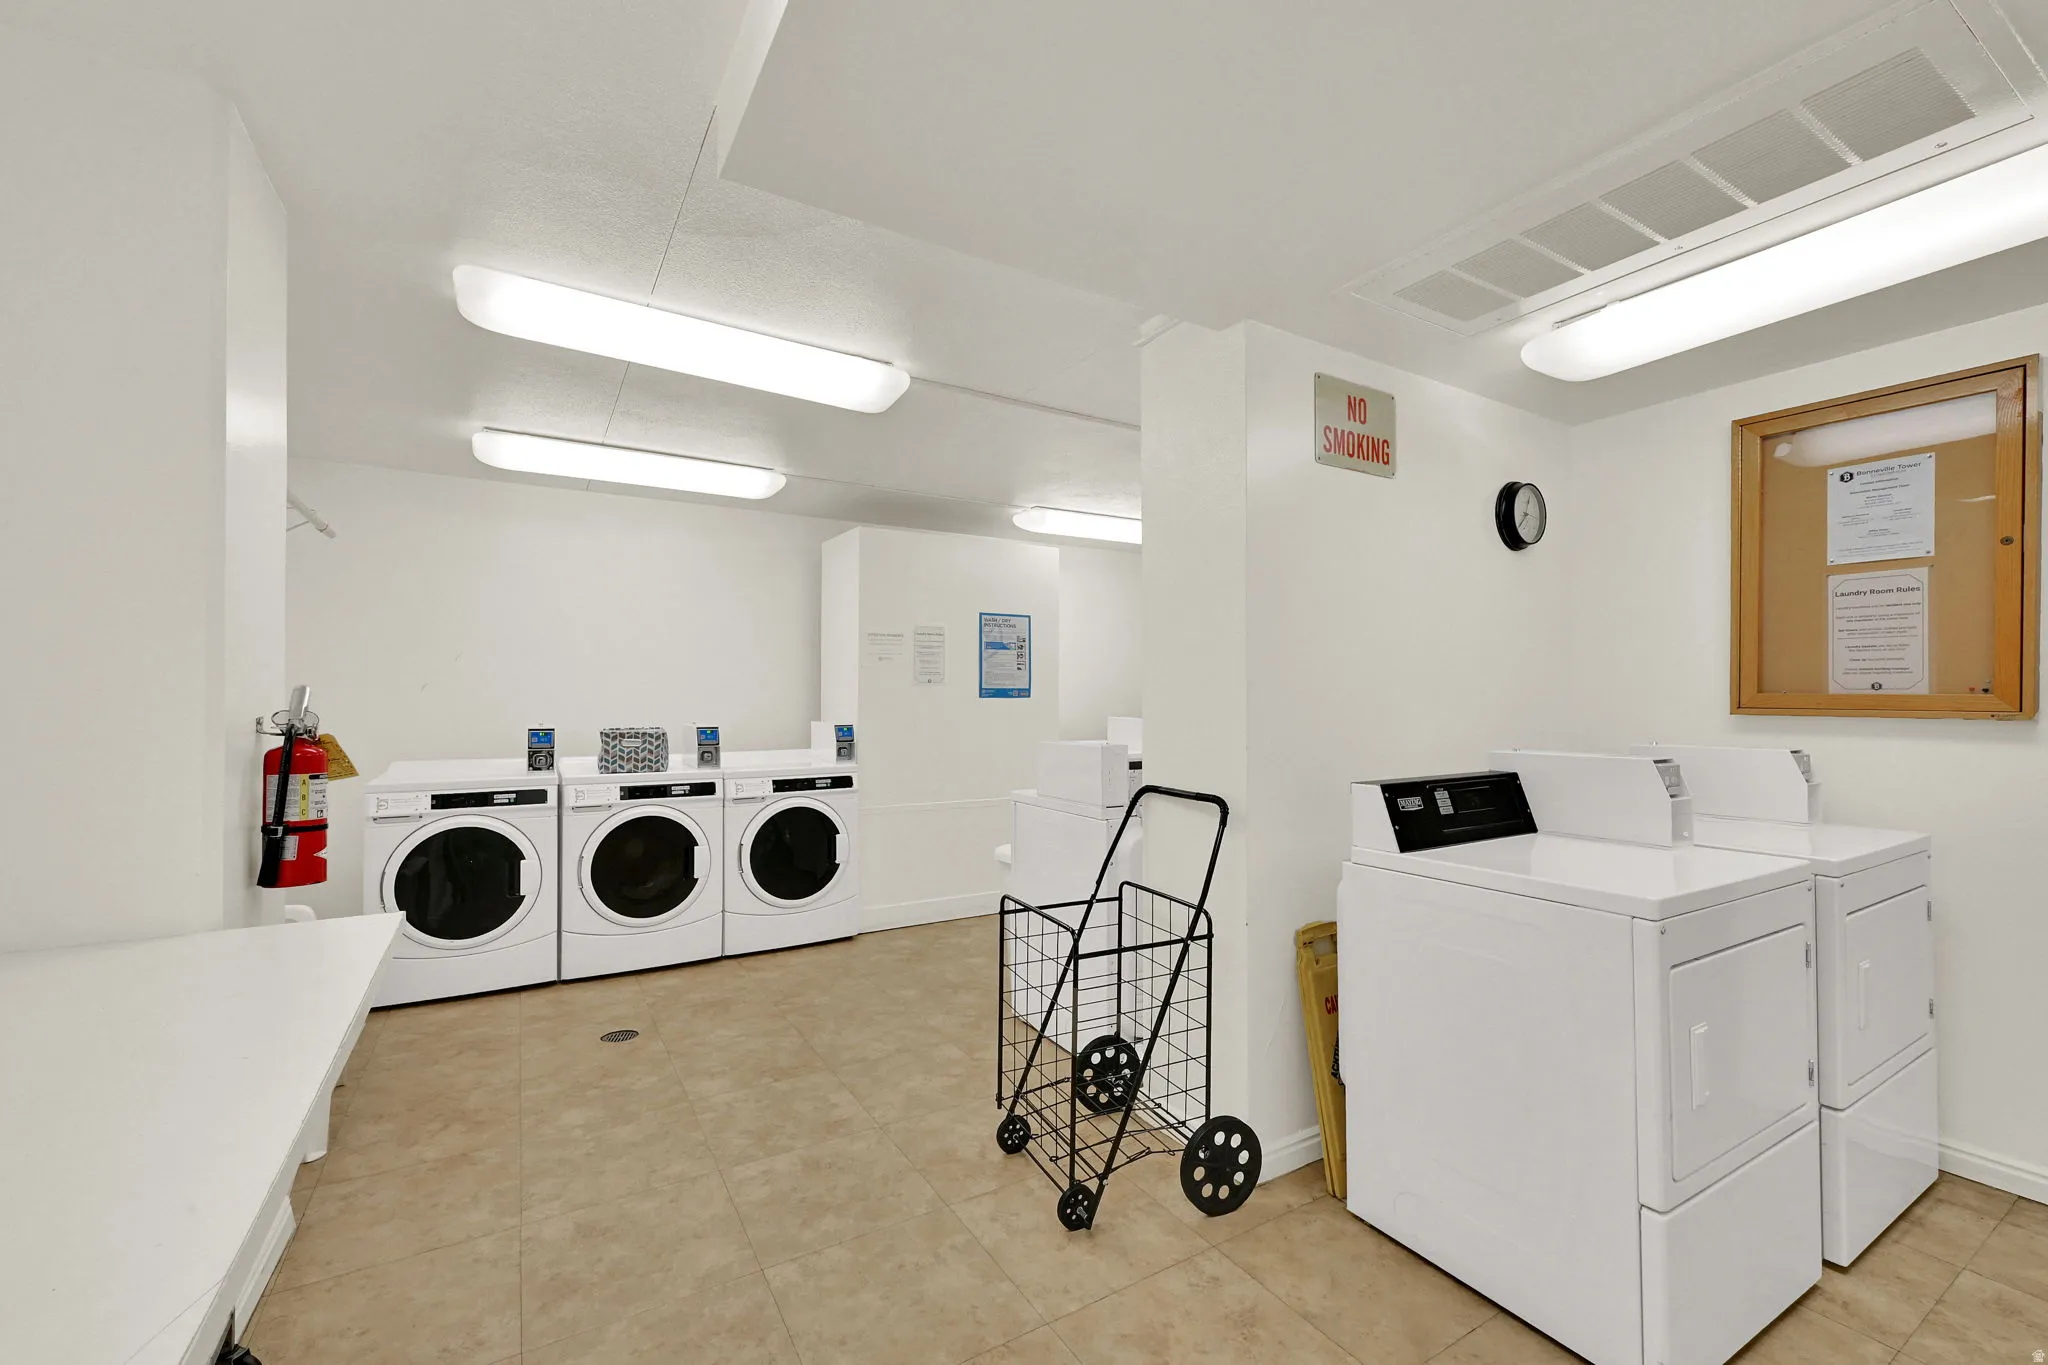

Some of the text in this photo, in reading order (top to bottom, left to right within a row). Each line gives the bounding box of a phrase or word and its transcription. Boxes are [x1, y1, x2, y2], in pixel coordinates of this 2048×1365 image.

[1347, 394, 1367, 425] NO
[1323, 425, 1390, 466] SMOKING
[1856, 466, 1895, 476] Bonneville
[1834, 589, 1868, 598] Laundry
[1896, 585, 1921, 593] Rules
[301, 778, 307, 786] A
[301, 793, 307, 801] B
[301, 808, 307, 816] C
